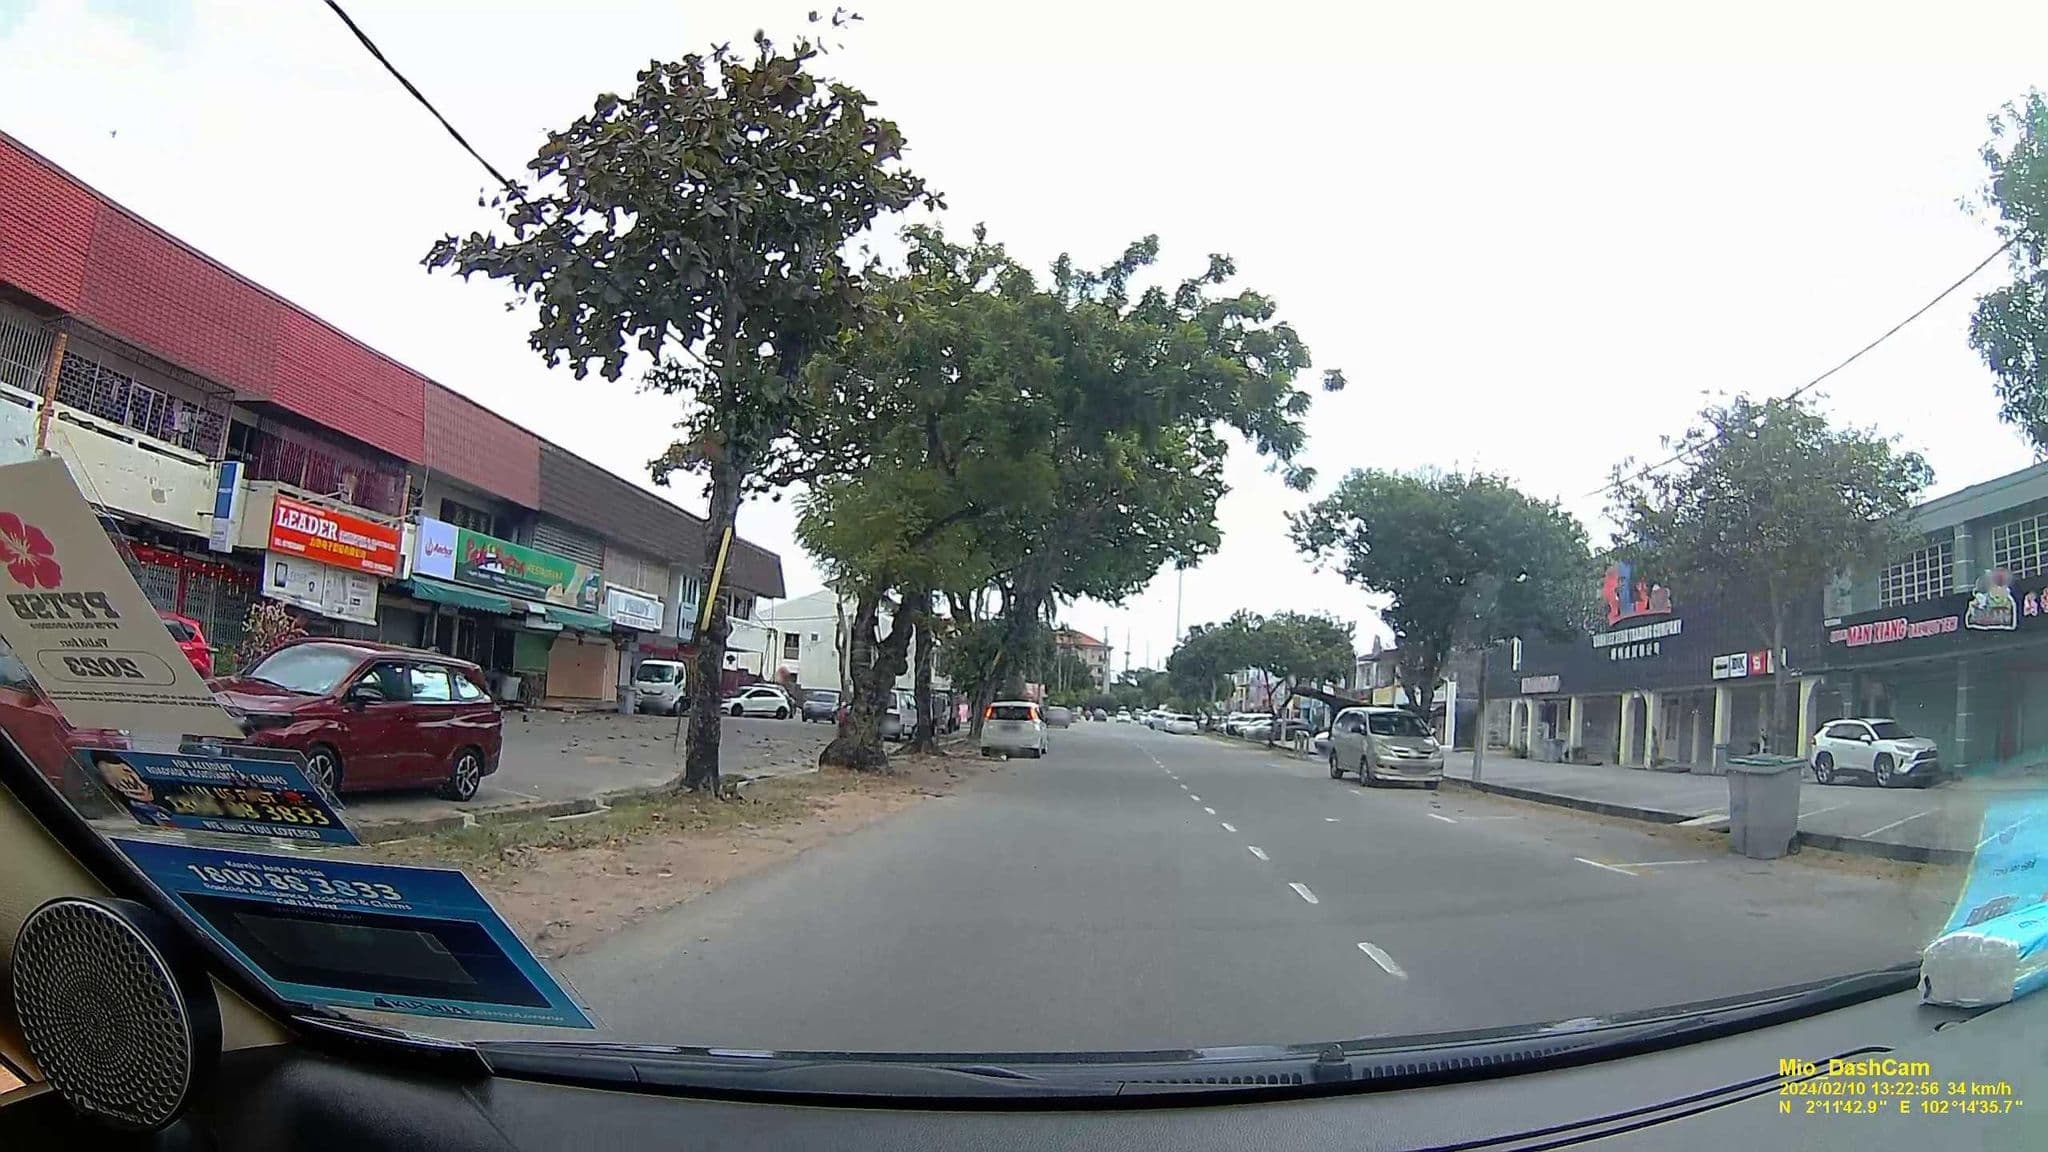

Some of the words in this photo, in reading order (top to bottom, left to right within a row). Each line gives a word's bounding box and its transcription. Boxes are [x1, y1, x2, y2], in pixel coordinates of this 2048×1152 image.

[277, 507, 340, 540] LEADER
[1846, 623, 1873, 646] MAN
[261, 803, 330, 825] 3833
[248, 824, 273, 835] YOU
[273, 827, 320, 839] COVERED
[187, 865, 262, 887] 1800
[263, 873, 309, 892] 88
[309, 877, 402, 900] 3833
[370, 900, 413, 910] Claims
